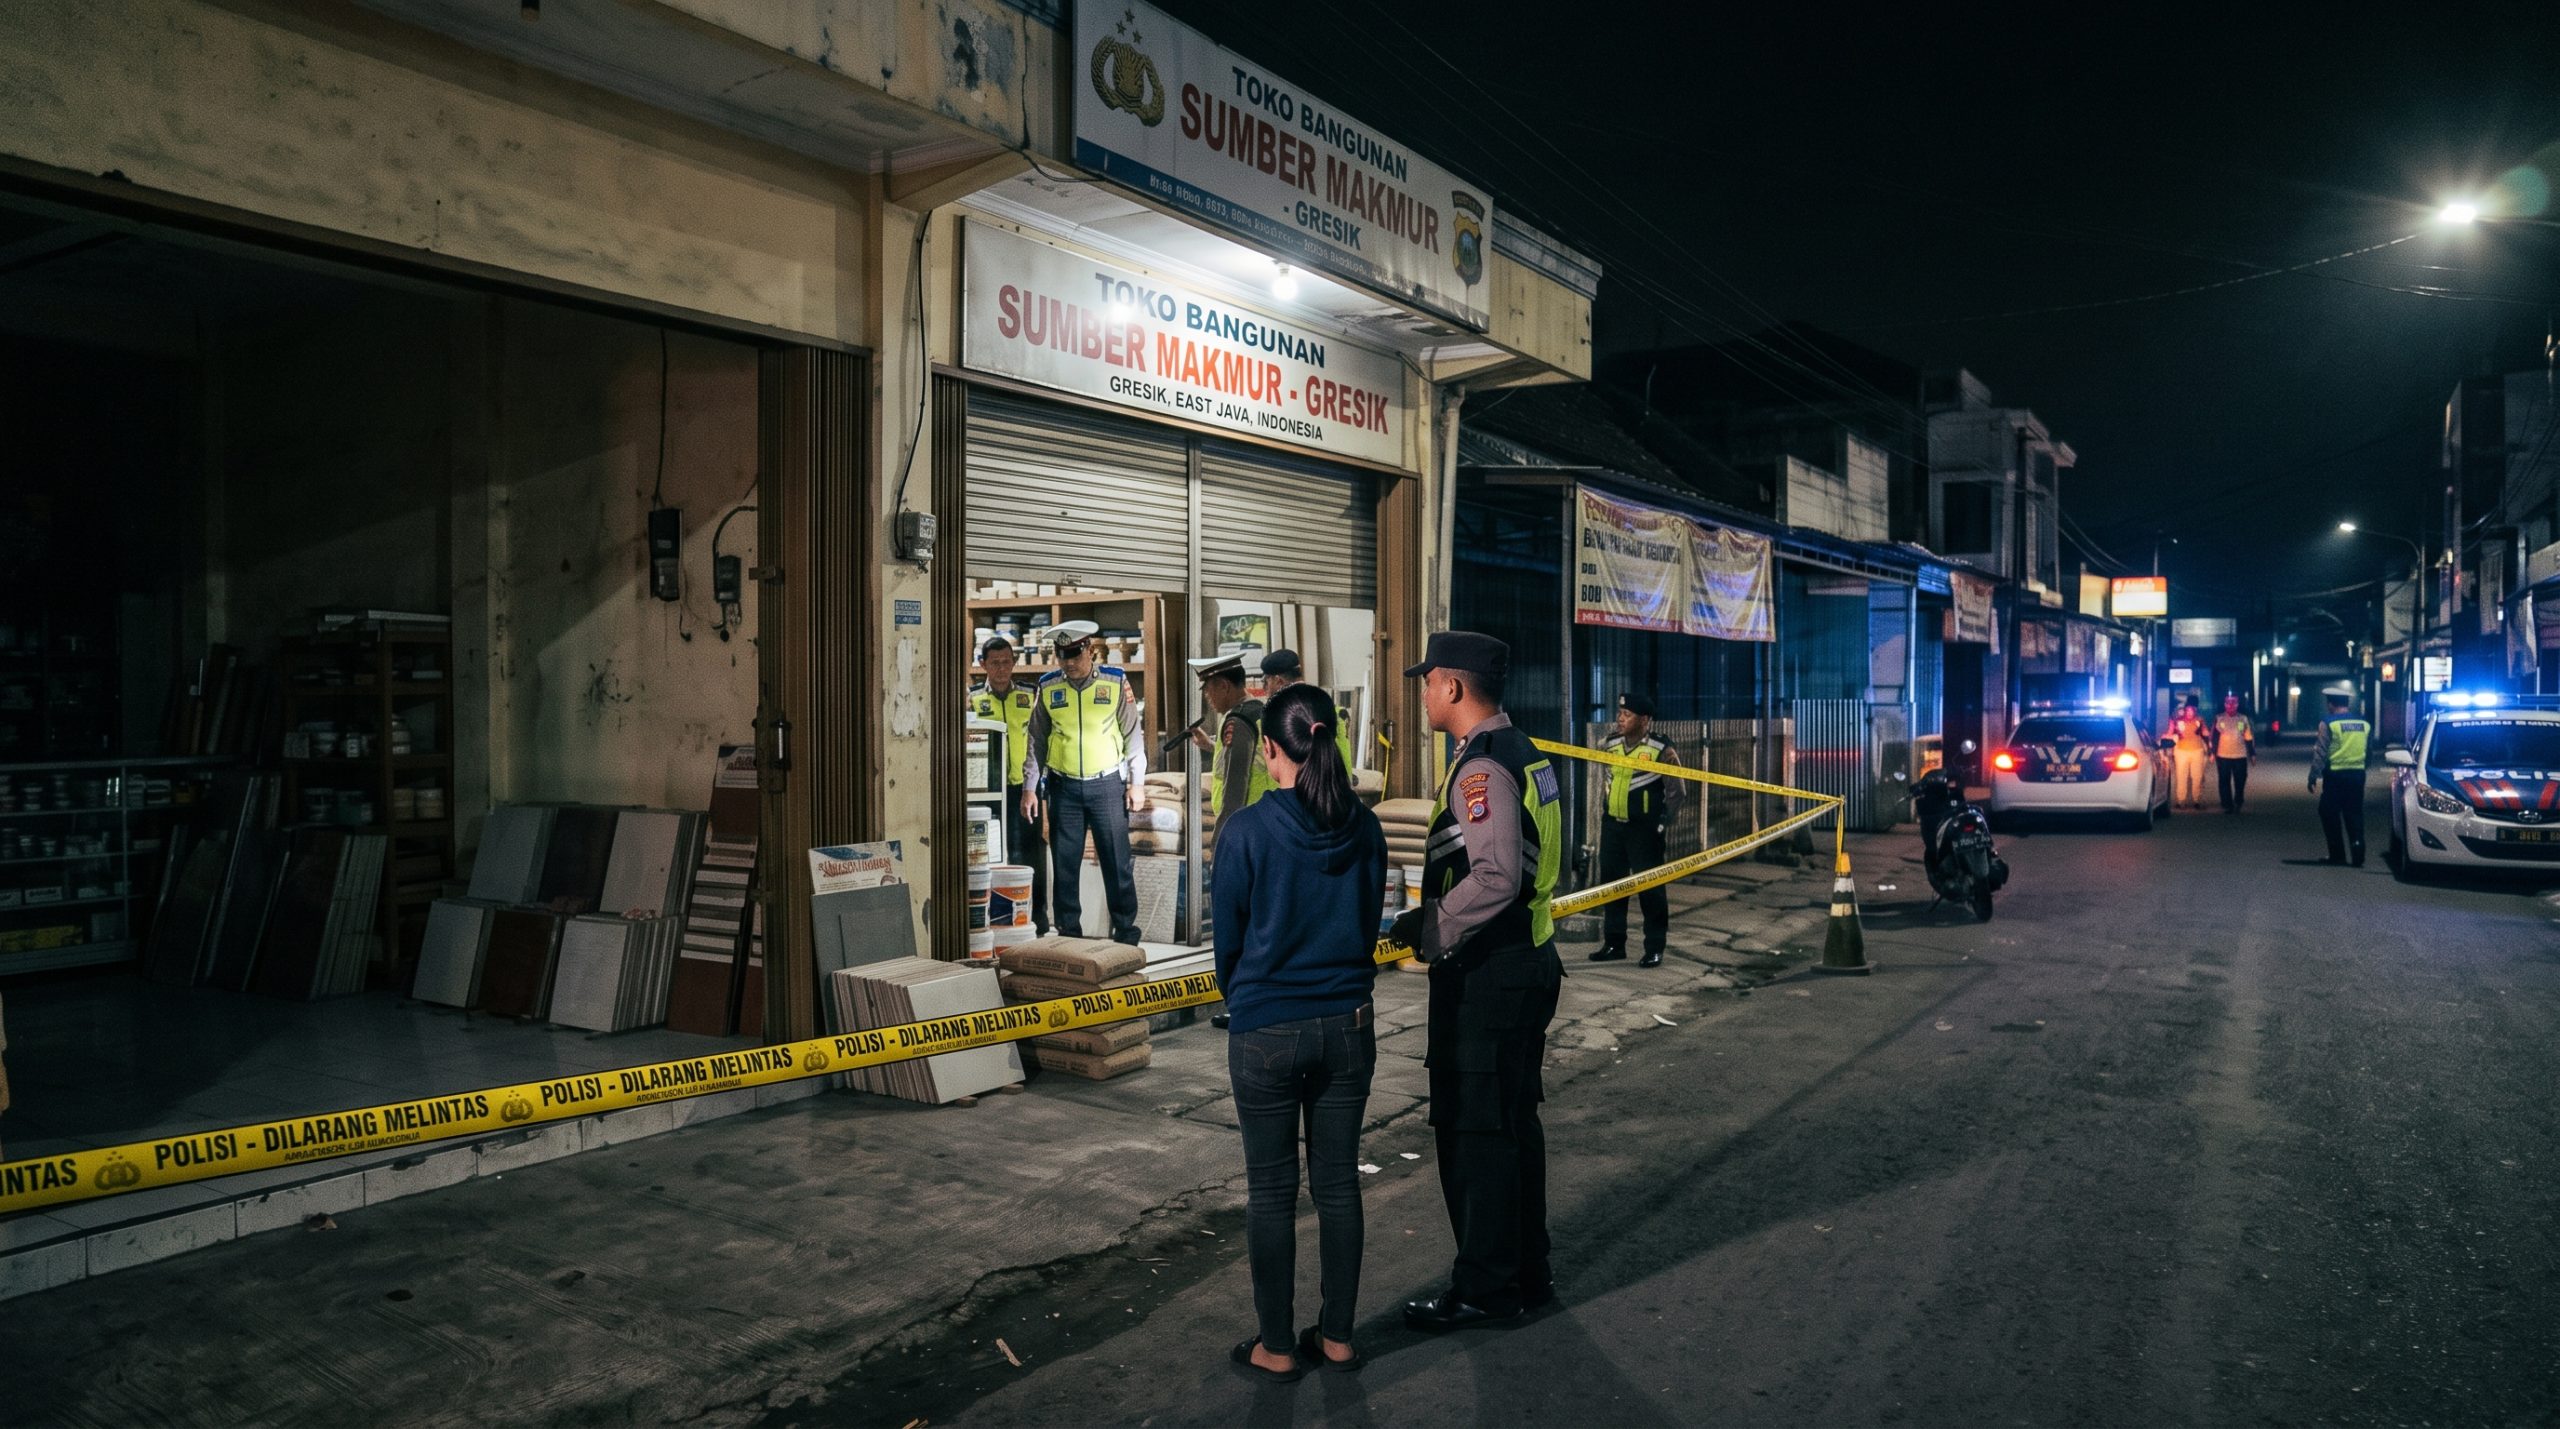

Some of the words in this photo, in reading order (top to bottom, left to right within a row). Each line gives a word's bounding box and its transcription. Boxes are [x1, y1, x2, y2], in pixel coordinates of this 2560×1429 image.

[1232, 65, 1293, 123] TOKO
[1301, 105, 1408, 184] BANGUNAN
[1179, 83, 1317, 197] SUMBER
[1327, 155, 1440, 255] MAKMUR
[1295, 200, 1362, 250] GRESIK
[1095, 271, 1177, 322] TOKO
[1186, 301, 1325, 369] BANGUNAN
[998, 284, 1146, 373] SUMBER
[1157, 331, 1282, 408] MAKMUR
[1305, 375, 1390, 435] GRESIK
[1109, 374, 1171, 407] GRESIK,
[1176, 391, 1213, 415] EAST
[1216, 402, 1254, 426] JAVA,
[1257, 410, 1324, 442] INDONESIA
[834, 1032, 885, 1059] POLISI
[898, 1018, 970, 1048] DILARANG
[973, 1005, 1041, 1033] MELINTAS
[1072, 994, 1114, 1017] POLISI
[1123, 980, 1183, 1007] DILARANG
[540, 1077, 603, 1107] POLISI
[620, 1060, 706, 1094] DILARANG
[710, 1047, 793, 1079] MELINTAS
[154, 1133, 238, 1170] POLISI
[263, 1112, 378, 1153] DILARANG
[383, 1095, 490, 1133] MELINTAS
